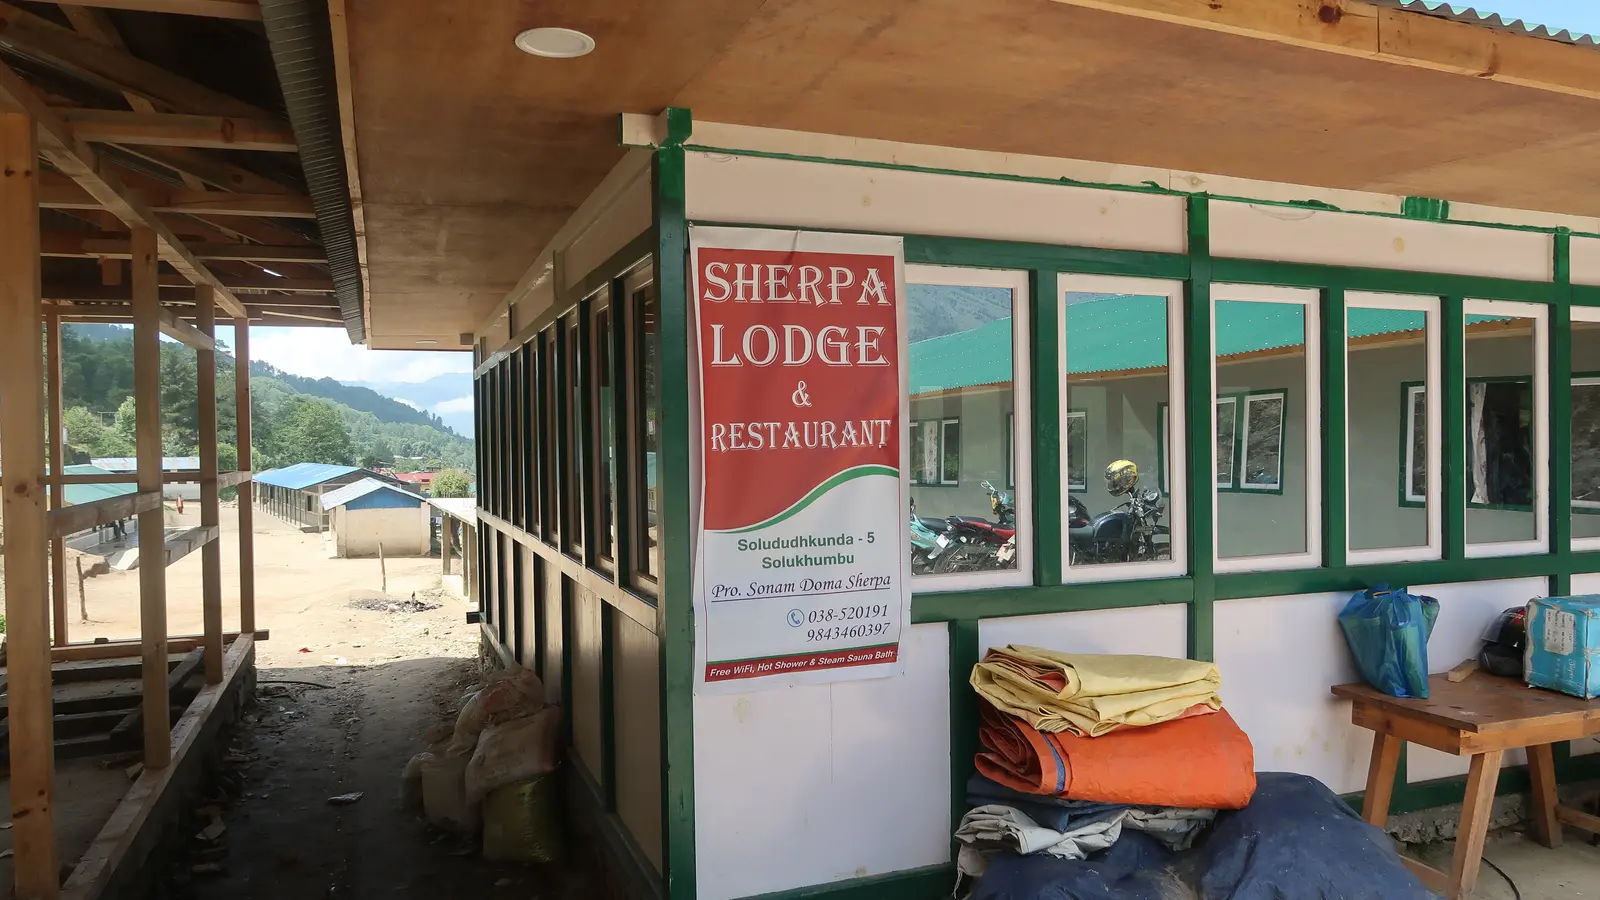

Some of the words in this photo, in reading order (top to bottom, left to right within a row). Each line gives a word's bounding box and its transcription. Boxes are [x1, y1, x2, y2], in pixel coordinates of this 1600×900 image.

[703, 261, 892, 307] SHERPA
[710, 324, 891, 367] LODGE
[791, 380, 812, 407] &
[711, 419, 892, 453] RESTAURANT
[737, 533, 854, 551] Solududhkunda
[867, 531, 875, 543] 5
[762, 553, 855, 569] Solukhumbu
[711, 584, 742, 598] Pro.
[747, 581, 796, 597] Sonam
[800, 578, 843, 592] Doma
[846, 572, 891, 590] Sherpa
[808, 604, 888, 623] 038-520191
[806, 622, 890, 642] 9843460397
[710, 668, 731, 677] Free
[733, 664, 755, 674] WiFi,
[757, 662, 772, 671] Hot
[774, 660, 808, 670] Shower
[809, 658, 816, 666] &
[818, 656, 845, 665] Steam
[847, 652, 873, 662] Sauna
[875, 650, 894, 659] Bath
